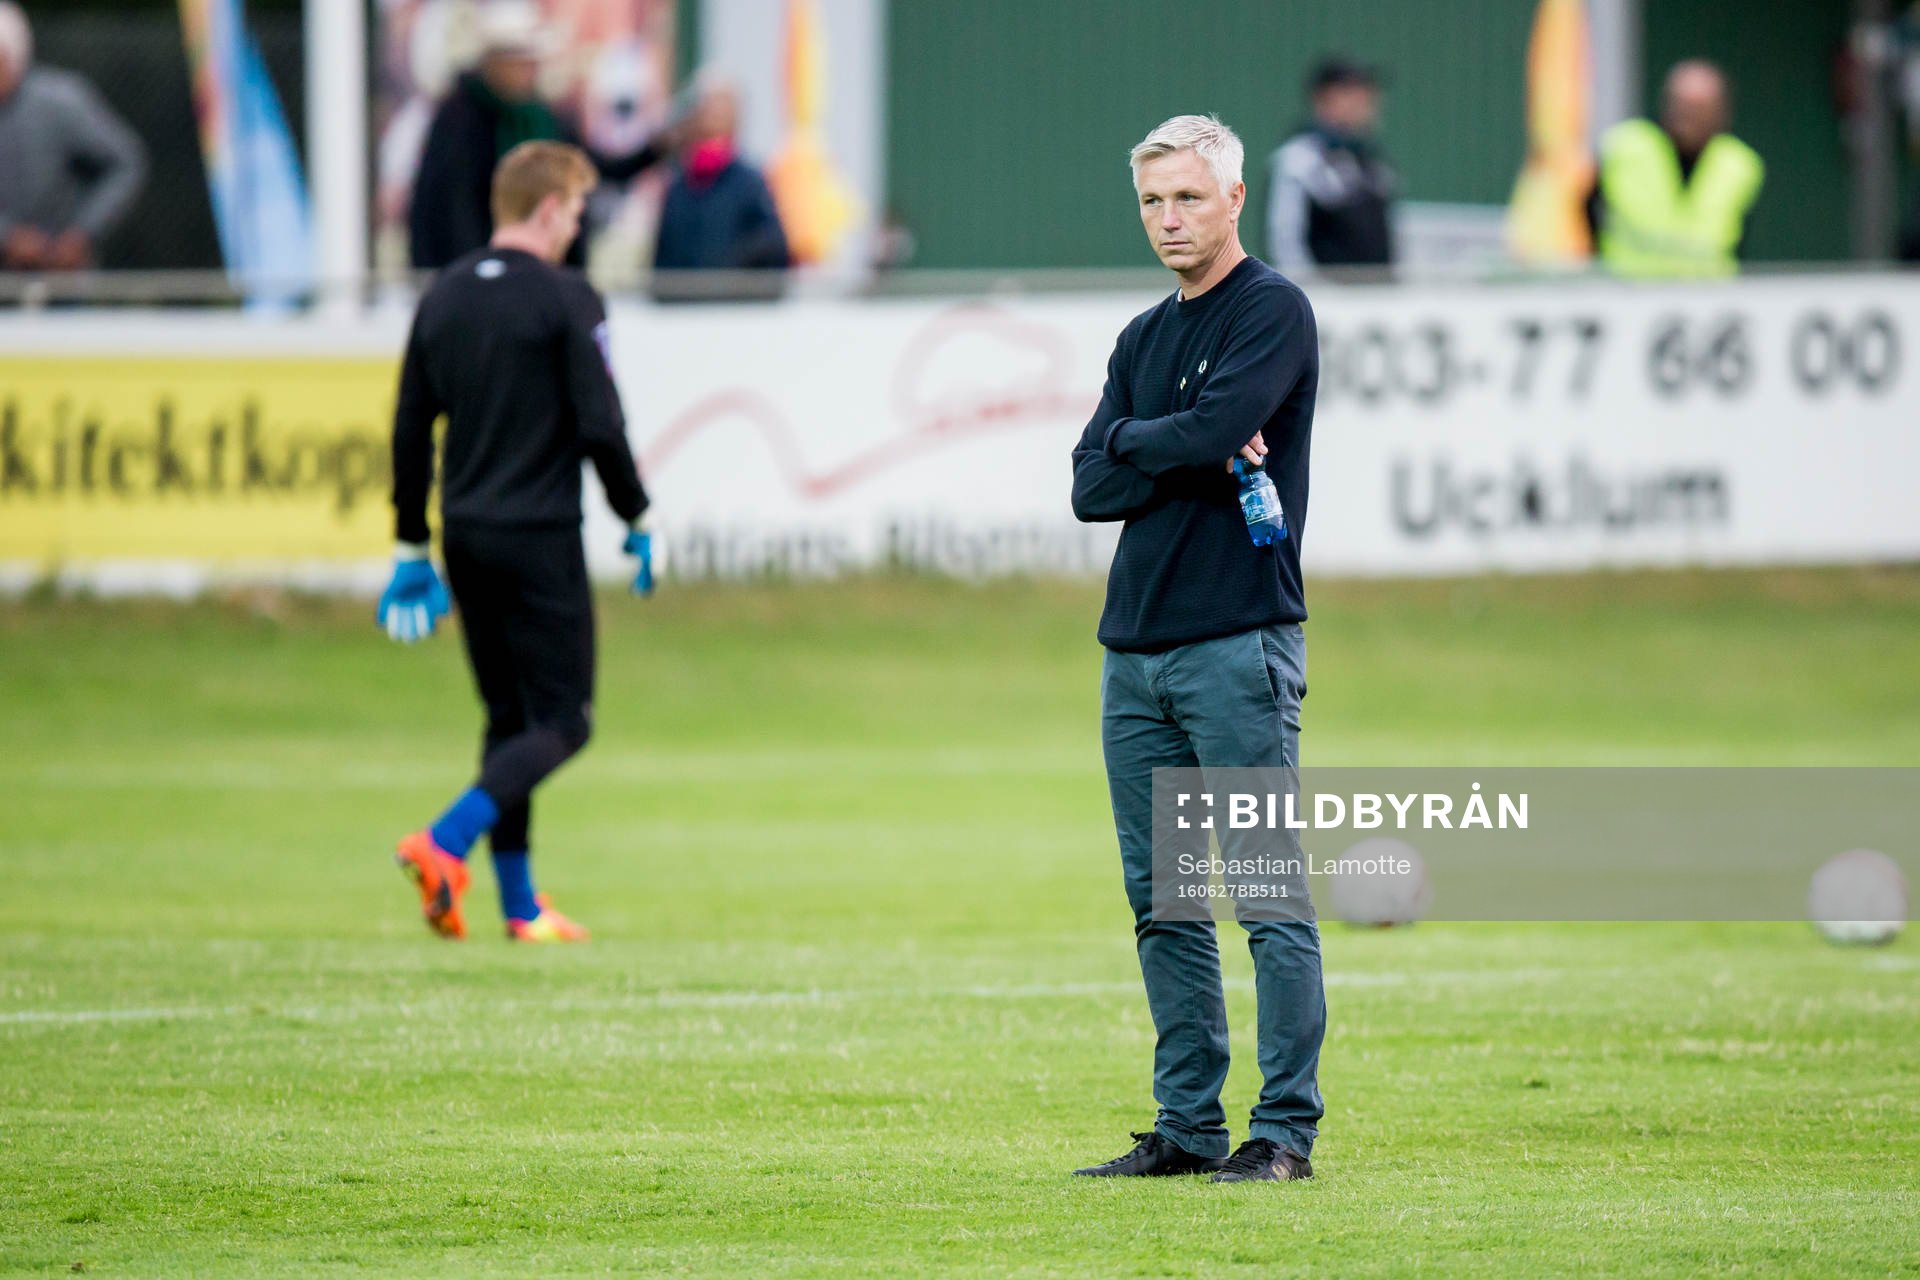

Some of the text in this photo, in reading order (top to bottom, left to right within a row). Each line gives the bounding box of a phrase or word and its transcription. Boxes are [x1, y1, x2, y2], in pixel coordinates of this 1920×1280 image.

[1646, 312, 1754, 396] 66
[1790, 308, 1904, 394] 00
[1388, 452, 1734, 538] Ucklum
